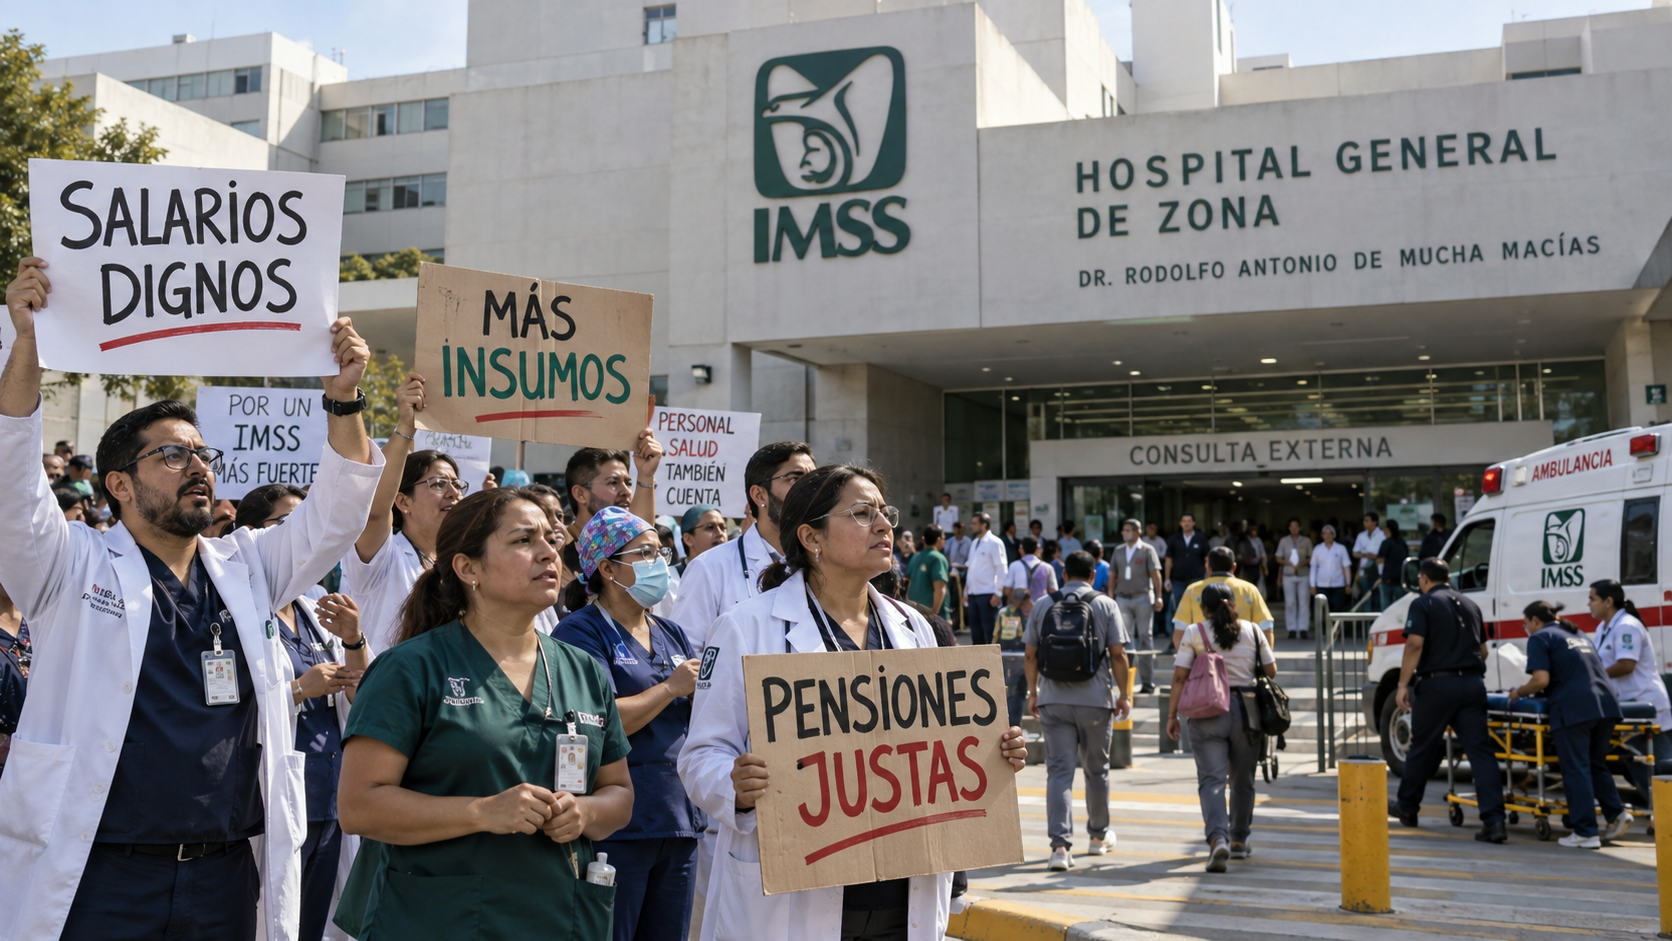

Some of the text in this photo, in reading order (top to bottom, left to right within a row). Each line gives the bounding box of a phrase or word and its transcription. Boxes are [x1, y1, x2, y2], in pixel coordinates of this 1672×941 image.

[1077, 127, 1557, 193] HOSPITAL GENERAL
[754, 195, 912, 264] IMSS
[1077, 194, 1280, 239] DE ZONA
[1079, 232, 1600, 287] DR. RODOLFO ANTONIO DE MUCHA MACÍAS
[100, 258, 298, 325] DIGNOS
[483, 282, 577, 341] MÁS
[229, 394, 312, 417] POR UN
[232, 424, 301, 452] IMSS
[658, 411, 735, 435] PERSONAL
[668, 438, 719, 458] SALUD
[1130, 437, 1393, 467] CONSULTA EXTERNA
[257, 462, 320, 484] FUERTE
[1531, 448, 1613, 482] AMBULANCIA
[666, 486, 722, 507] CUENTA
[1541, 564, 1584, 589] IMSS
[796, 735, 988, 828] JUSTAS
